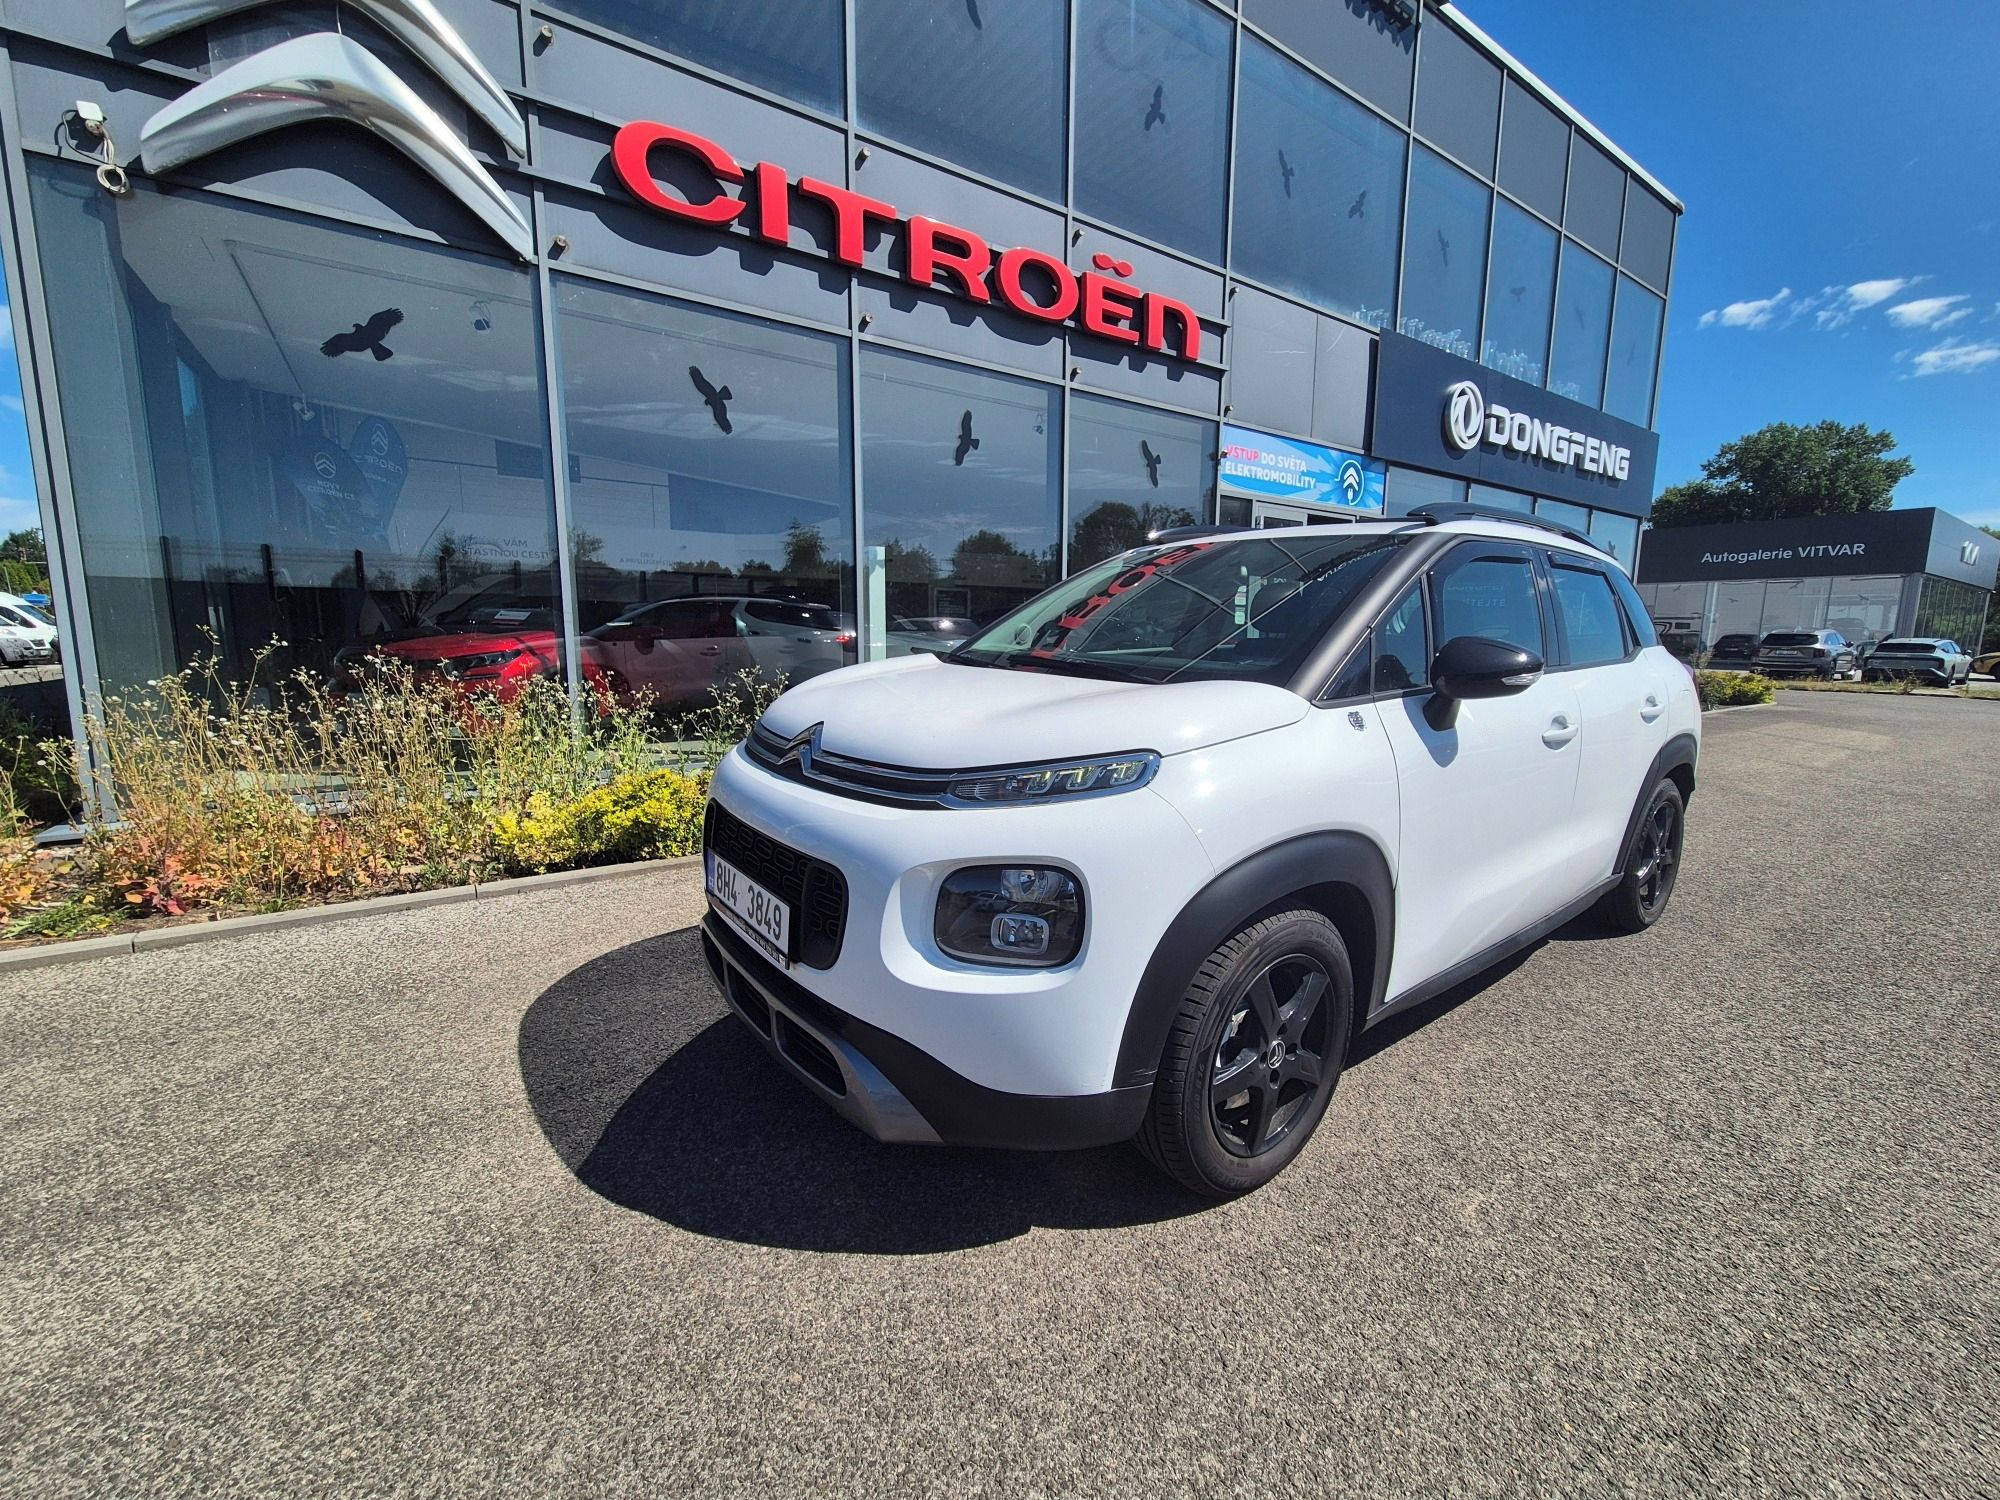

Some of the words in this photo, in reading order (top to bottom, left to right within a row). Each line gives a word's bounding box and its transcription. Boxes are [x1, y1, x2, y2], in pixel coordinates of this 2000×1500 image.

[611, 120, 1201, 361] CITROËN
[1227, 446, 1260, 462] VSTUP
[1261, 453, 1276, 467] DO
[1277, 454, 1308, 473] SVĚTA
[1485, 403, 1631, 481] DONGFENG
[1225, 461, 1316, 489] ELEKTROMOBILITY
[1701, 547, 1793, 564] Autogalerie
[1798, 543, 1866, 558] VITVAR
[716, 862, 738, 907] 8H4
[747, 884, 782, 941] 3849
